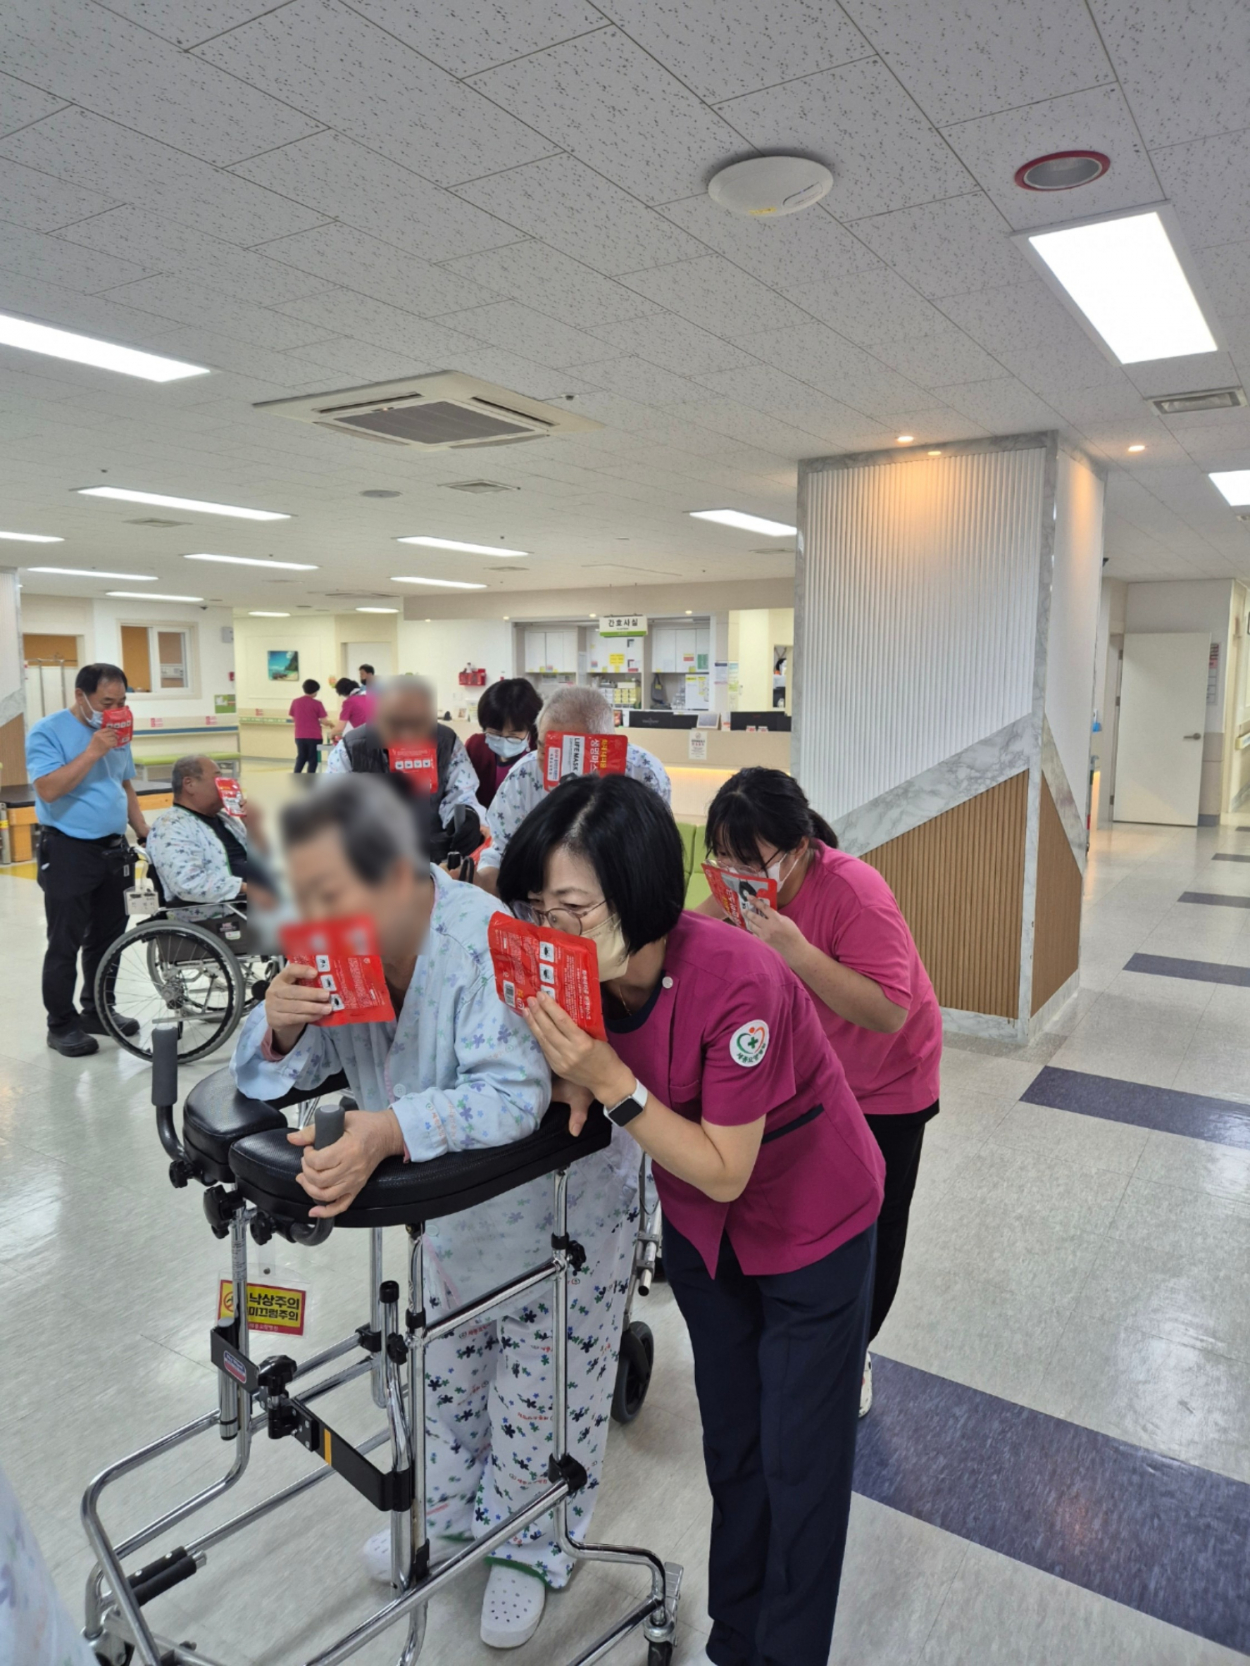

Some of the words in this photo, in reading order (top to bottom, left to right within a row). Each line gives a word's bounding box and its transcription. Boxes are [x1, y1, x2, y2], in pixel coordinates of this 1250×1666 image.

[608, 618, 638, 627] 간호사실
[590, 739, 600, 772] 생명마스
[249, 1292, 300, 1310] 낙상주의
[248, 1306, 299, 1321] 미끄럼주의
